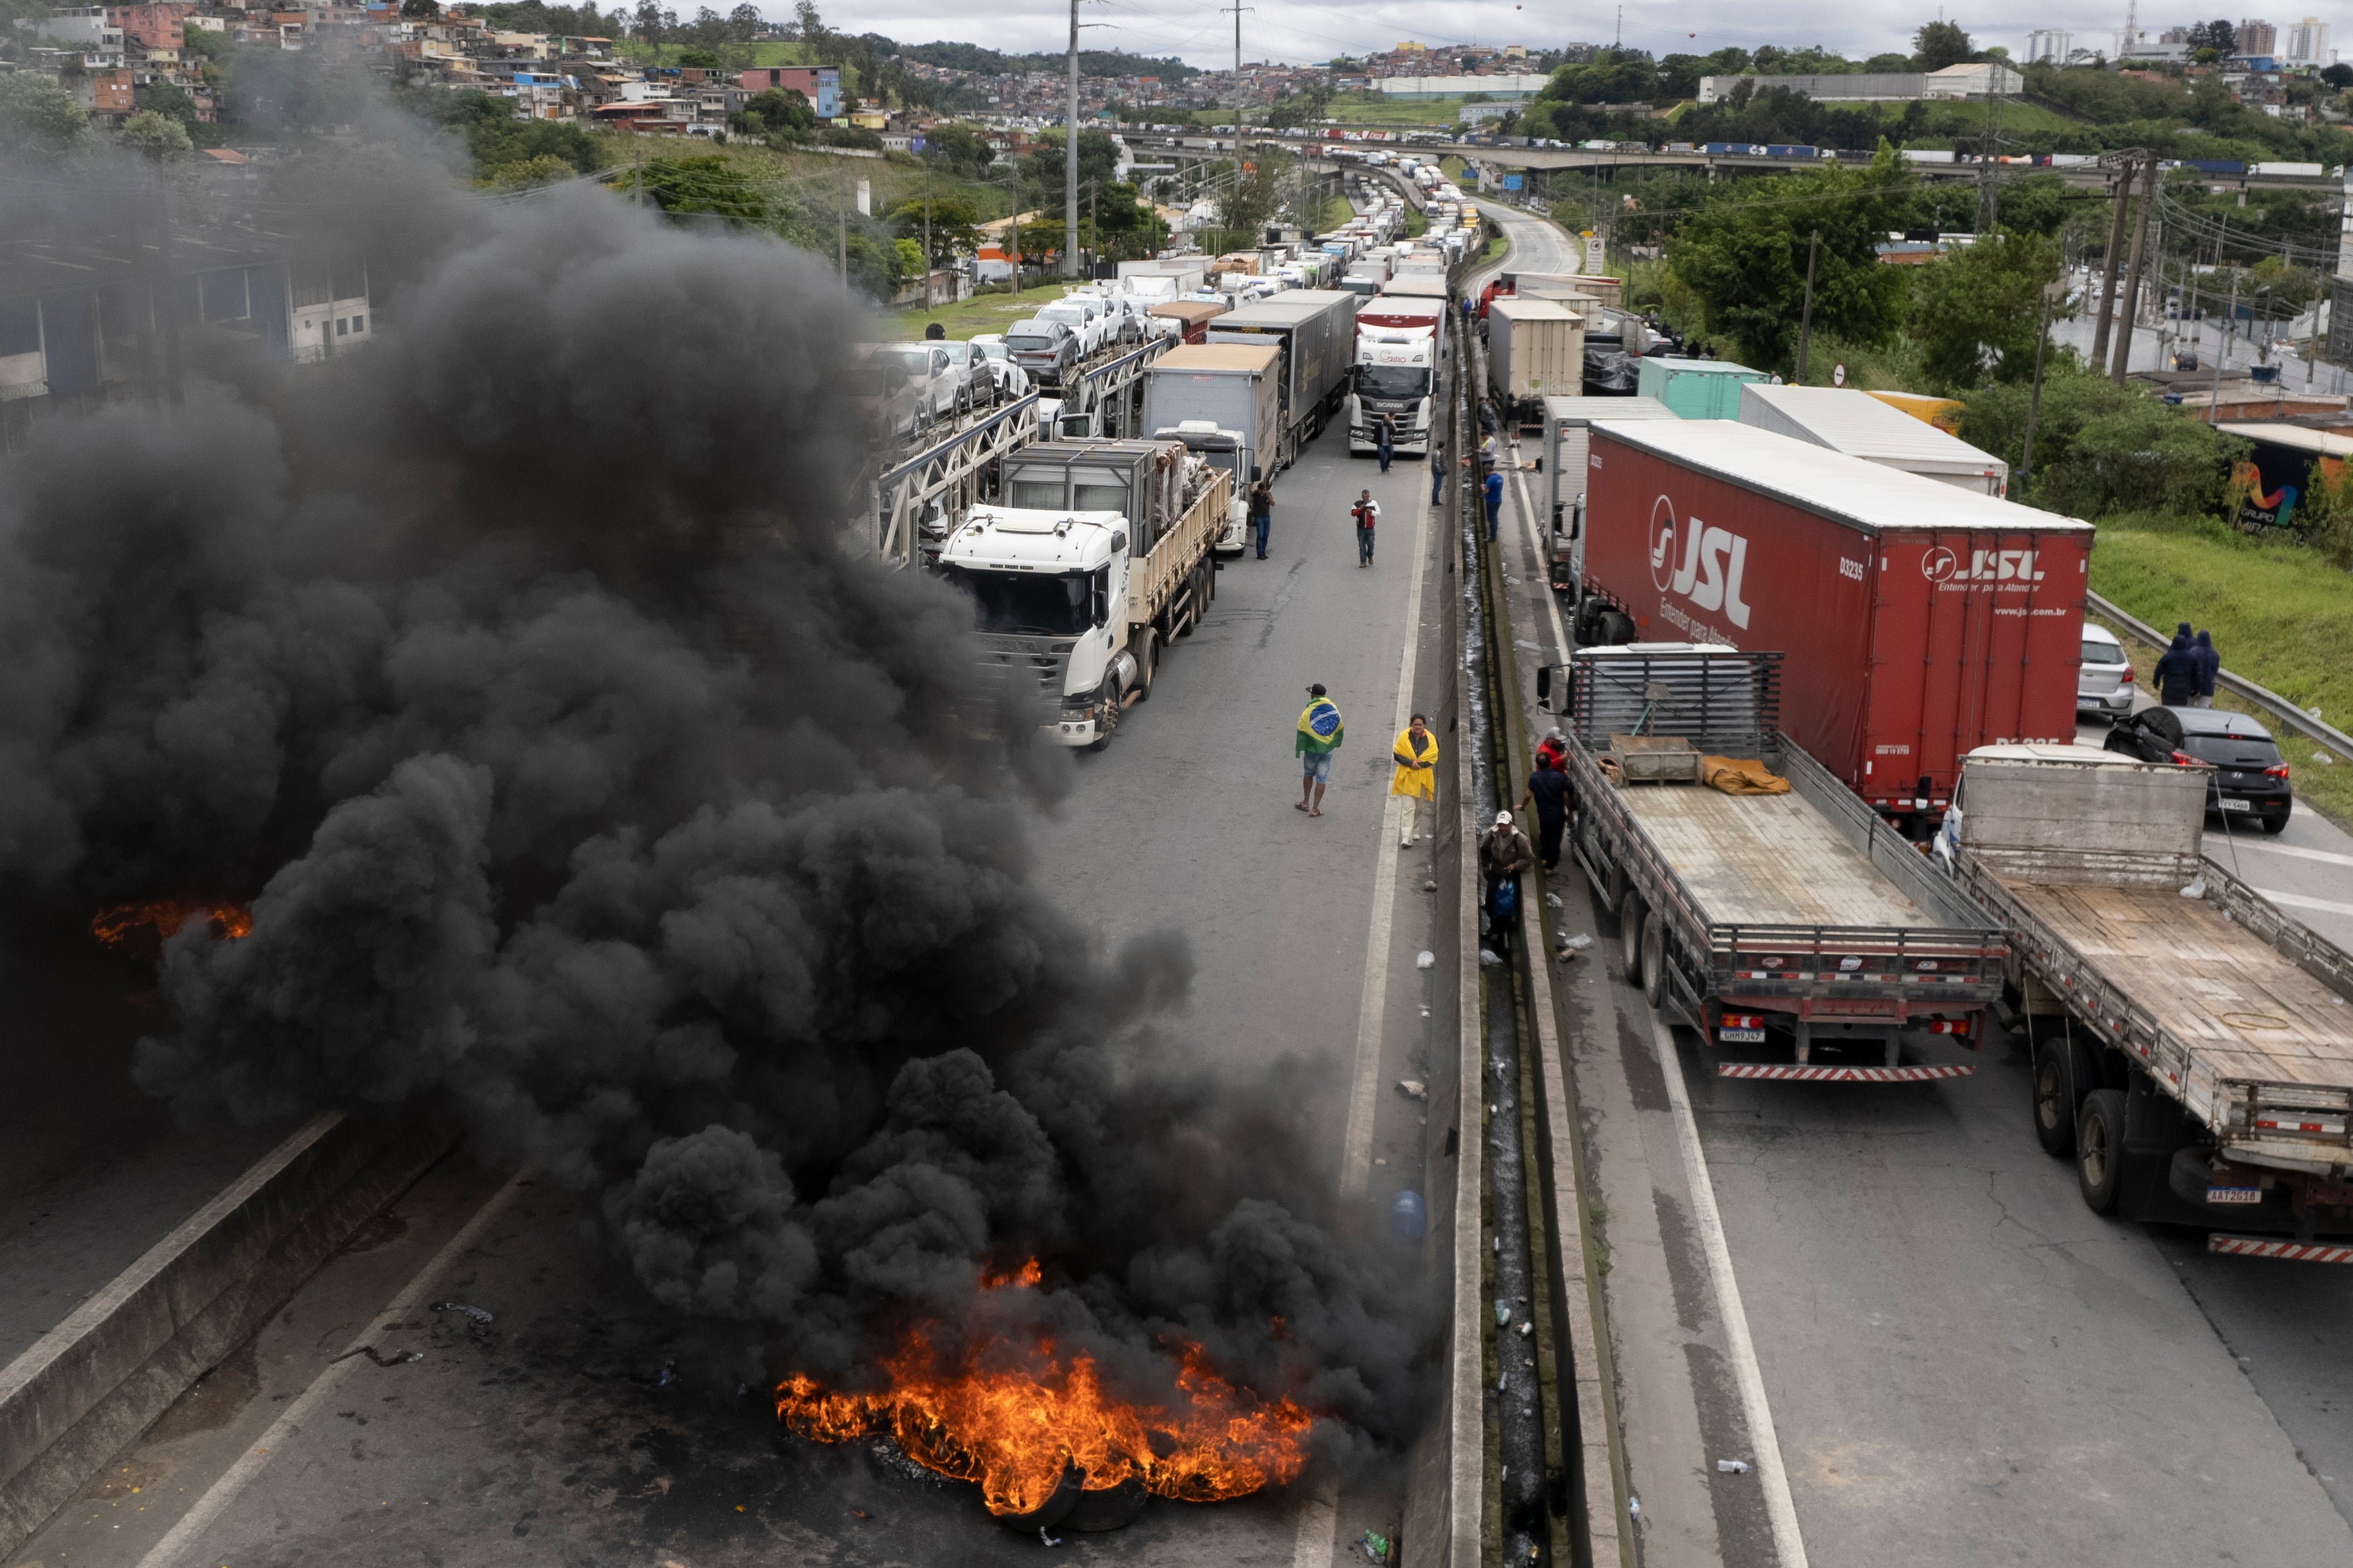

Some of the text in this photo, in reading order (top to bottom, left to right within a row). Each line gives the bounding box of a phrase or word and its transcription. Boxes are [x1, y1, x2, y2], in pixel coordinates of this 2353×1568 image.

[2241, 508, 2274, 523] GRUPO
[1672, 516, 1751, 630] JSL
[1840, 556, 1863, 581] D3235
[1954, 550, 2045, 581] JSL
[1983, 585, 2004, 593] paa
[1660, 597, 1690, 632] Entender
[1690, 618, 1708, 645] para
[1994, 608, 2067, 617] www.js.com.br
[1725, 1032, 1760, 1040] GHM9J47
